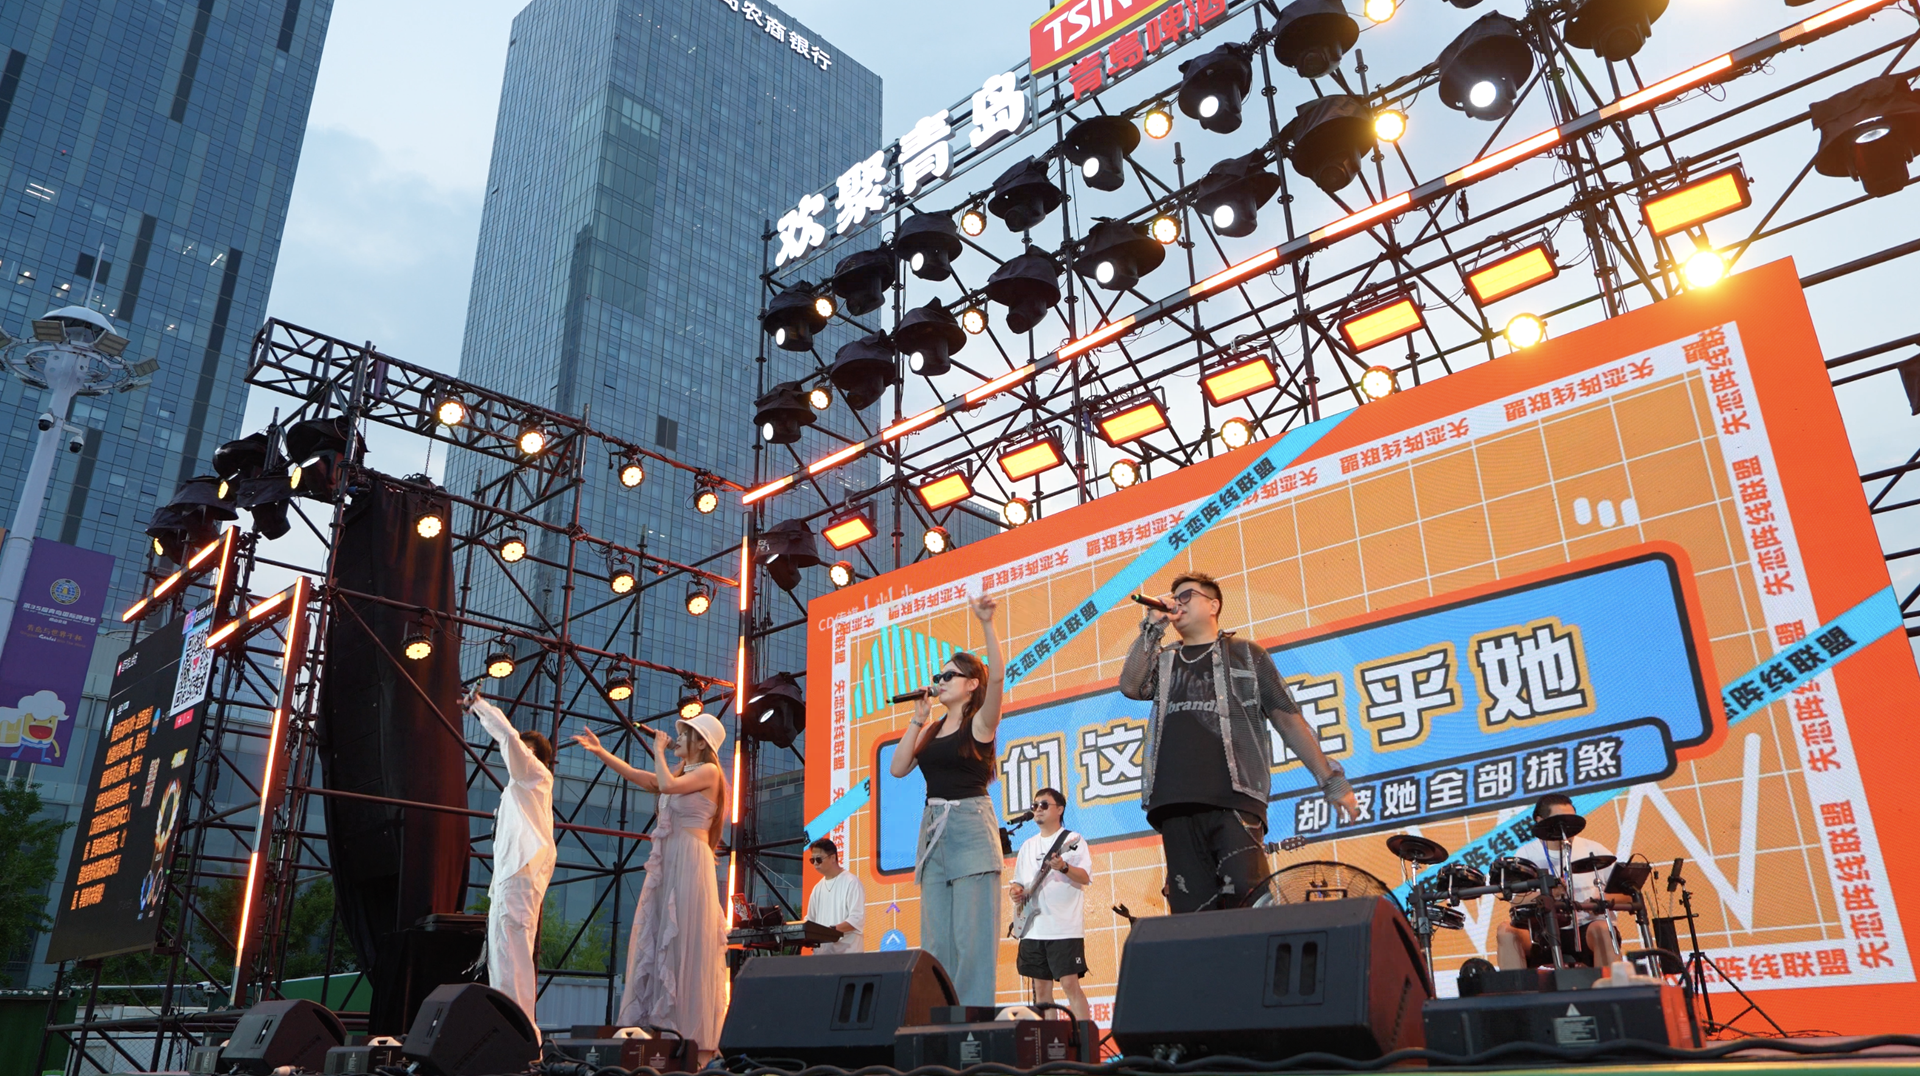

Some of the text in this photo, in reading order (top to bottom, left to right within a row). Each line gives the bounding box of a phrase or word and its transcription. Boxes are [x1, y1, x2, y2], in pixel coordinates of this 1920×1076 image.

[775, 71, 1028, 268] 欢聚青岛
[1503, 357, 1655, 422] 失恋阵线联盟
[1339, 417, 1470, 475] 失恋阵线联盟
[1168, 457, 1277, 551] 失恋阵线联盟
[1732, 455, 1795, 596] 失恋阵线联盟
[1005, 600, 1099, 684] 失恋阵线联盟
[834, 679, 845, 771] 失恋阵线联盟
[1820, 800, 1894, 969] 失恋阵线联盟
